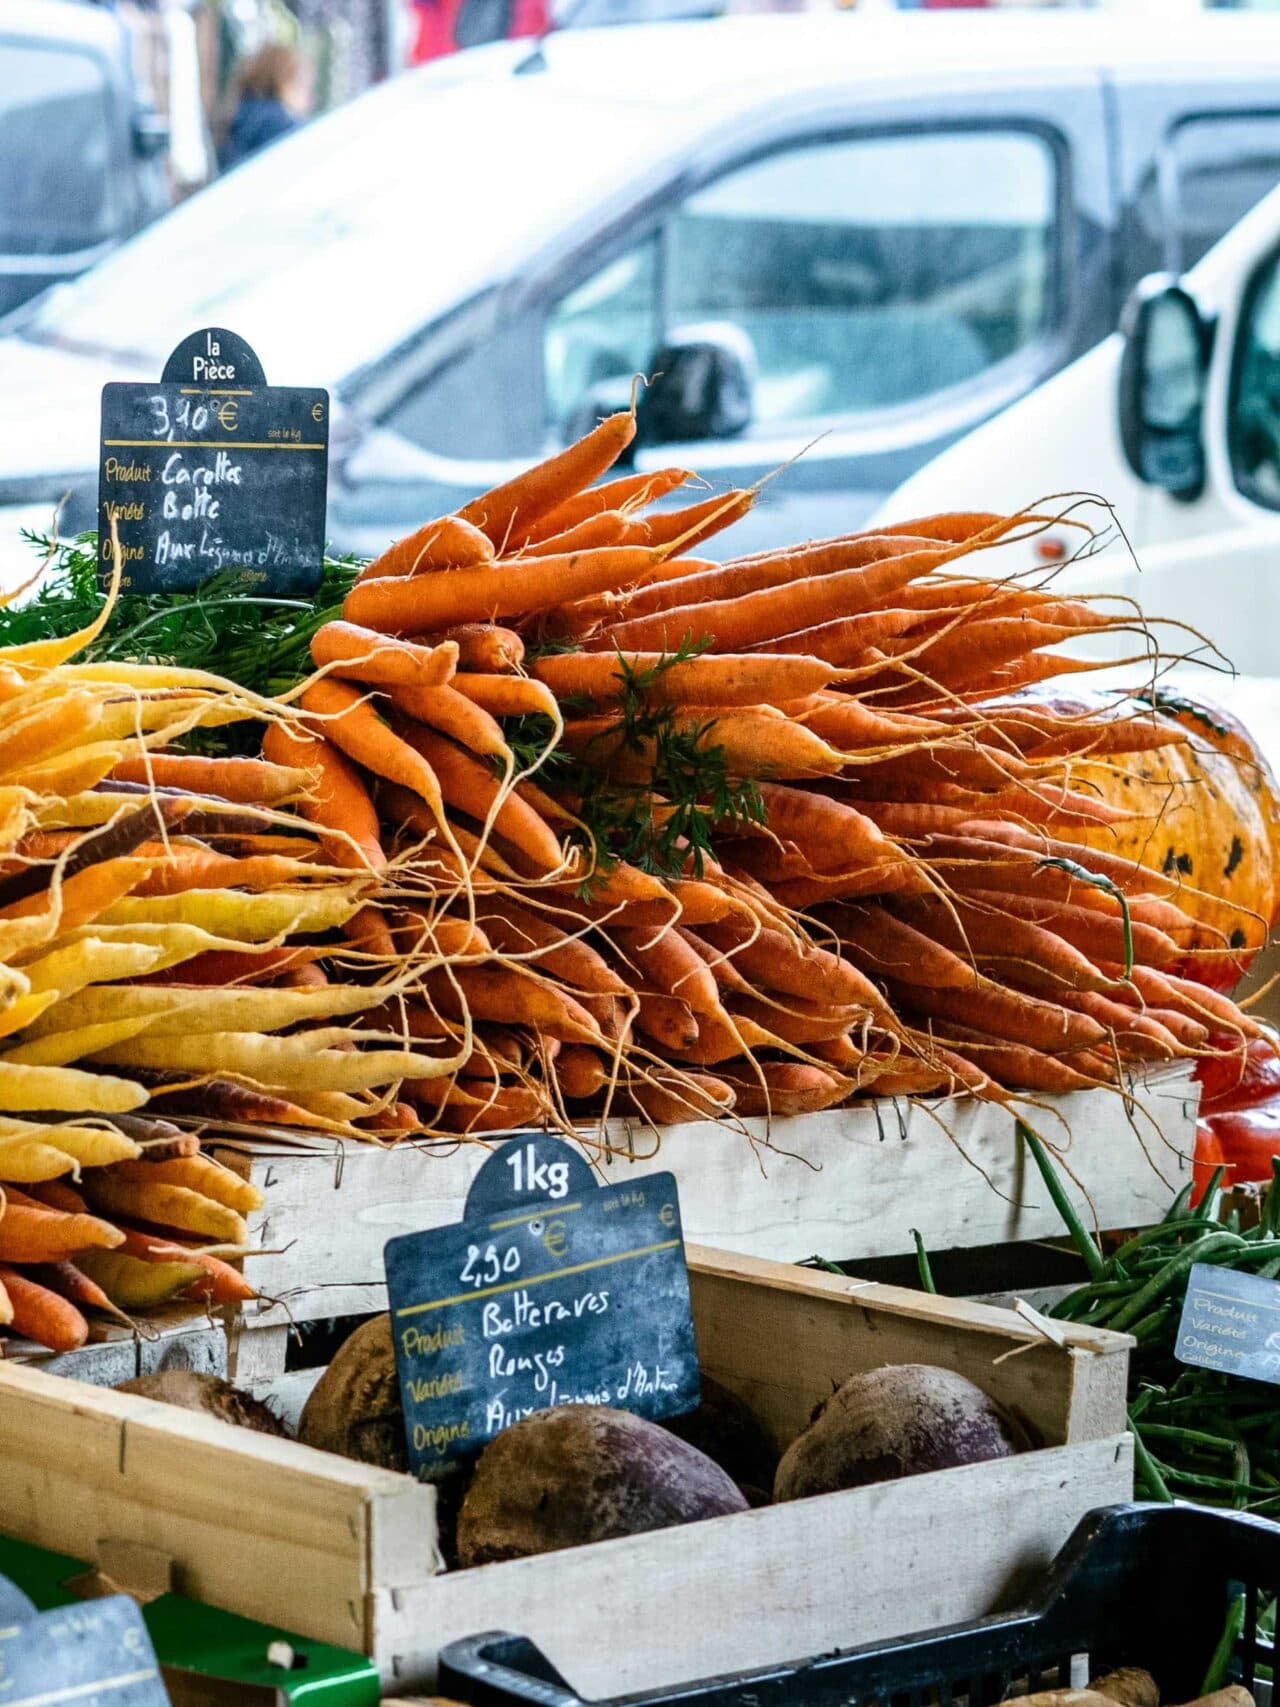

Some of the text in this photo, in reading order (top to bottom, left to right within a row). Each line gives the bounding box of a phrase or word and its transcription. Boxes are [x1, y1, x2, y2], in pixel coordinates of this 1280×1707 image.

[207, 332, 220, 356] la
[193, 356, 235, 381] Pièce
[149, 395, 239, 442] 3,10 €
[312, 403, 324, 422] €
[104, 457, 151, 483] Produit
[154, 530, 196, 565] Aux
[506, 1144, 569, 1198] 1kg
[658, 1204, 675, 1227] €
[542, 1221, 571, 1257] €
[1193, 1298, 1259, 1322] Produit
[402, 1323, 465, 1359] Produit
[1183, 1336, 1246, 1357] Origine
[413, 1420, 469, 1455] Origine
